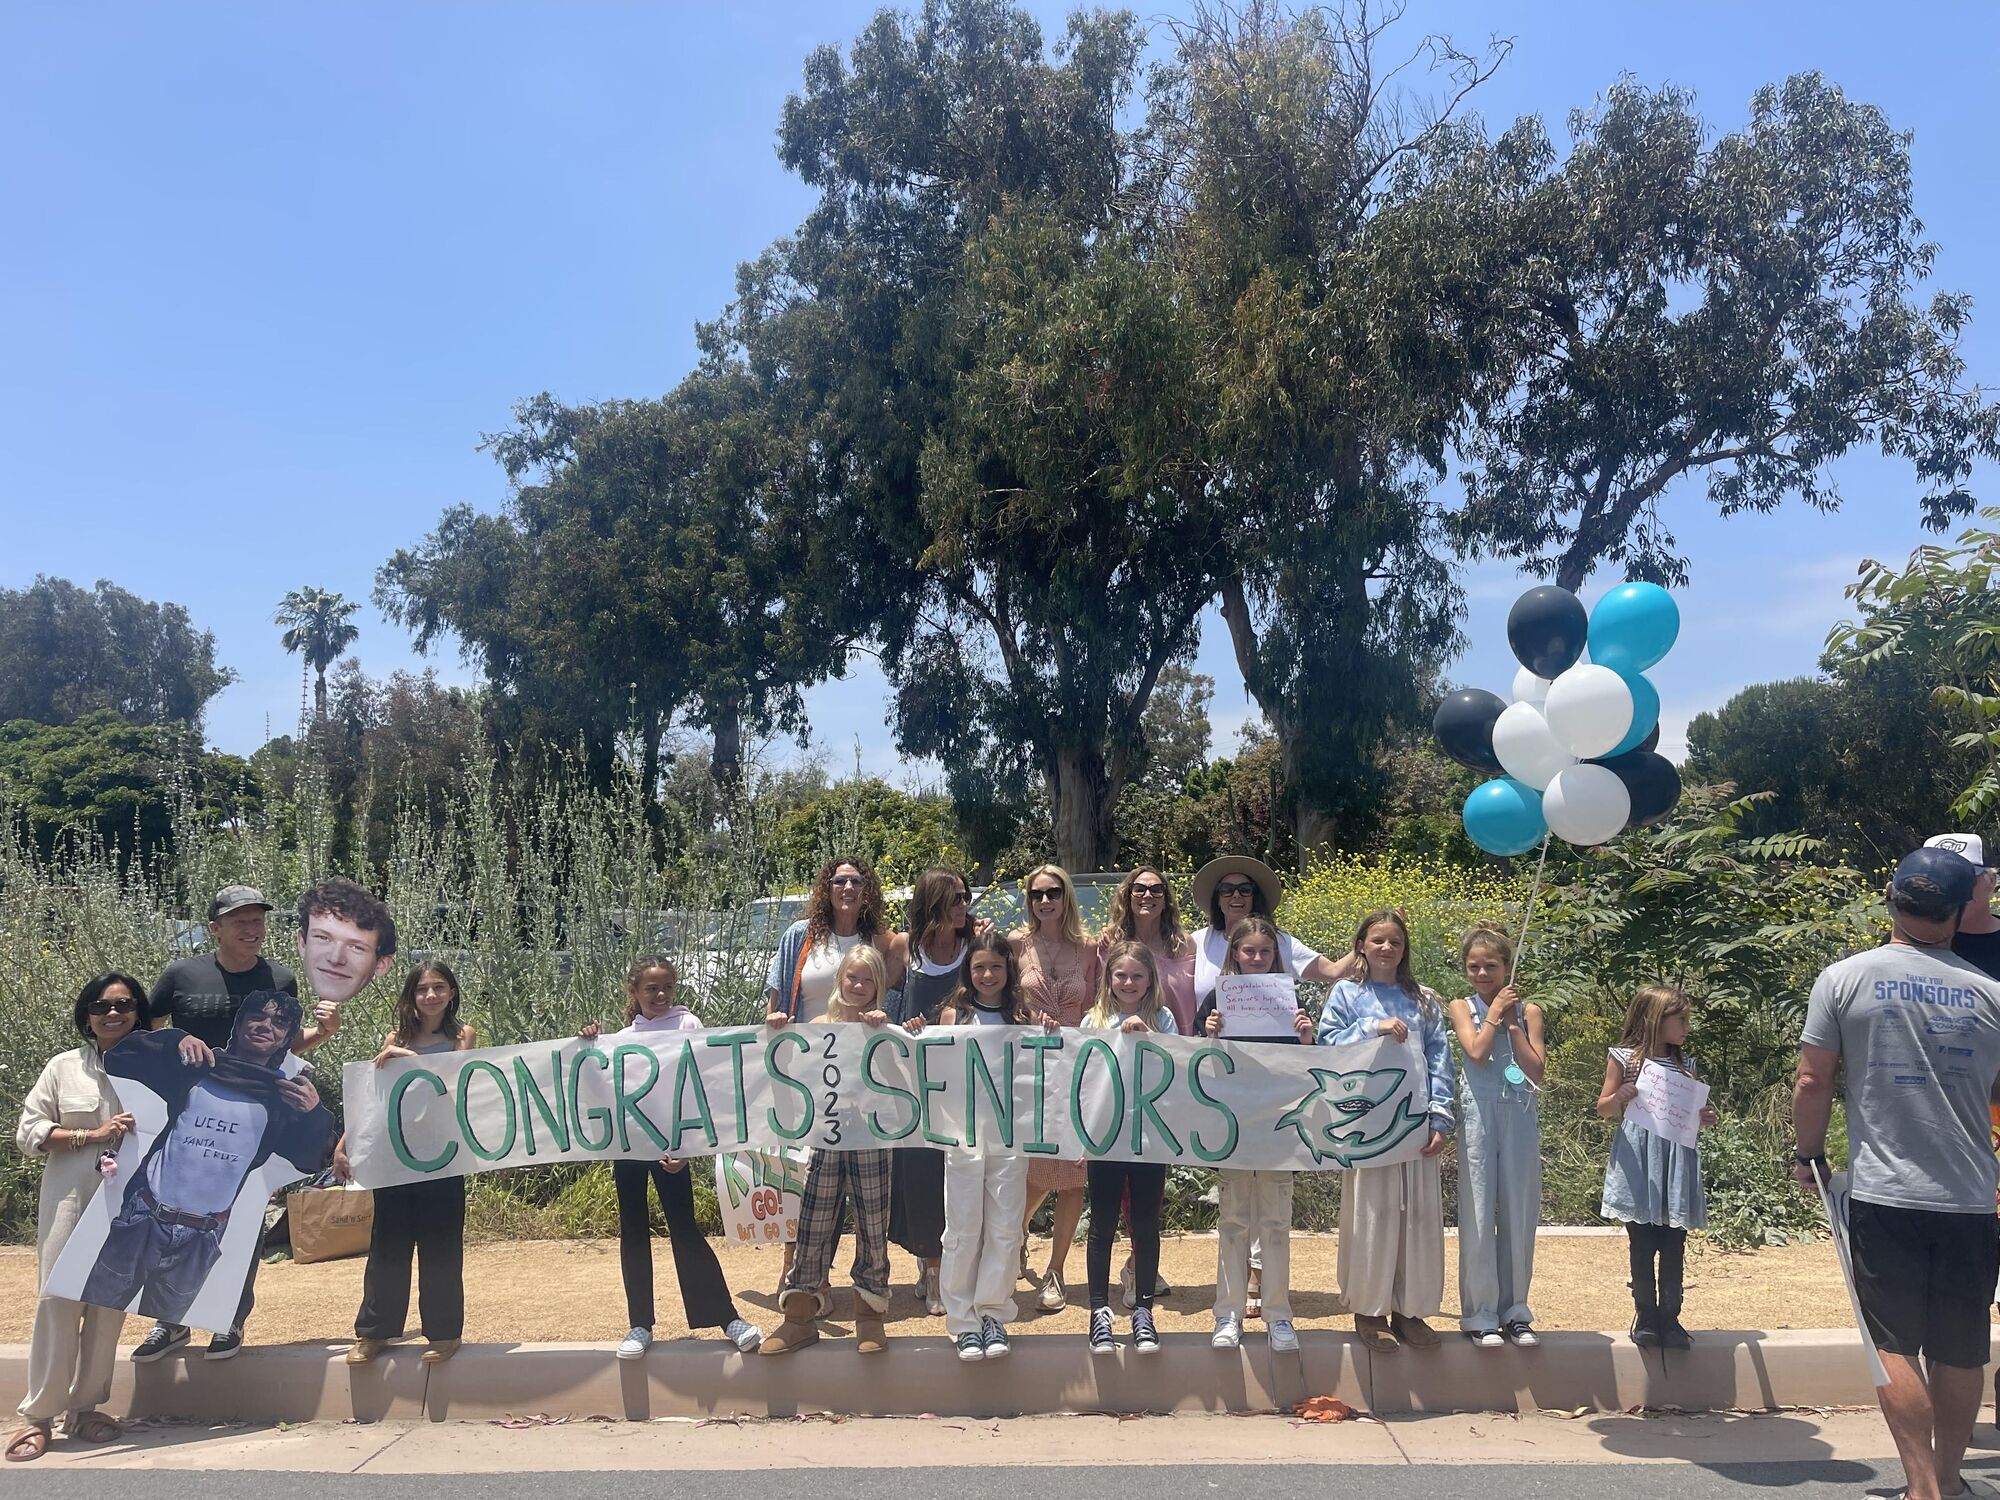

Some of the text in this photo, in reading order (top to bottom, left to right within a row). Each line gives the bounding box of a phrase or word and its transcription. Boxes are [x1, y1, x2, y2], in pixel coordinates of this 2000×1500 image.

[1906, 973, 1943, 986] THANK YOU
[1874, 980, 1976, 1009] SPONSORS
[1226, 1004, 1236, 1012] all
[387, 1032, 815, 1173] CONGRATS
[860, 1032, 1239, 1162] SENIORS
[194, 1115, 239, 1134] UCSC
[183, 1136, 215, 1147] SANTA
[203, 1149, 239, 1162] CRUZ
[751, 1188, 784, 1221] GO!
[331, 1215, 348, 1224] Sand
[763, 1222, 780, 1241] GO
